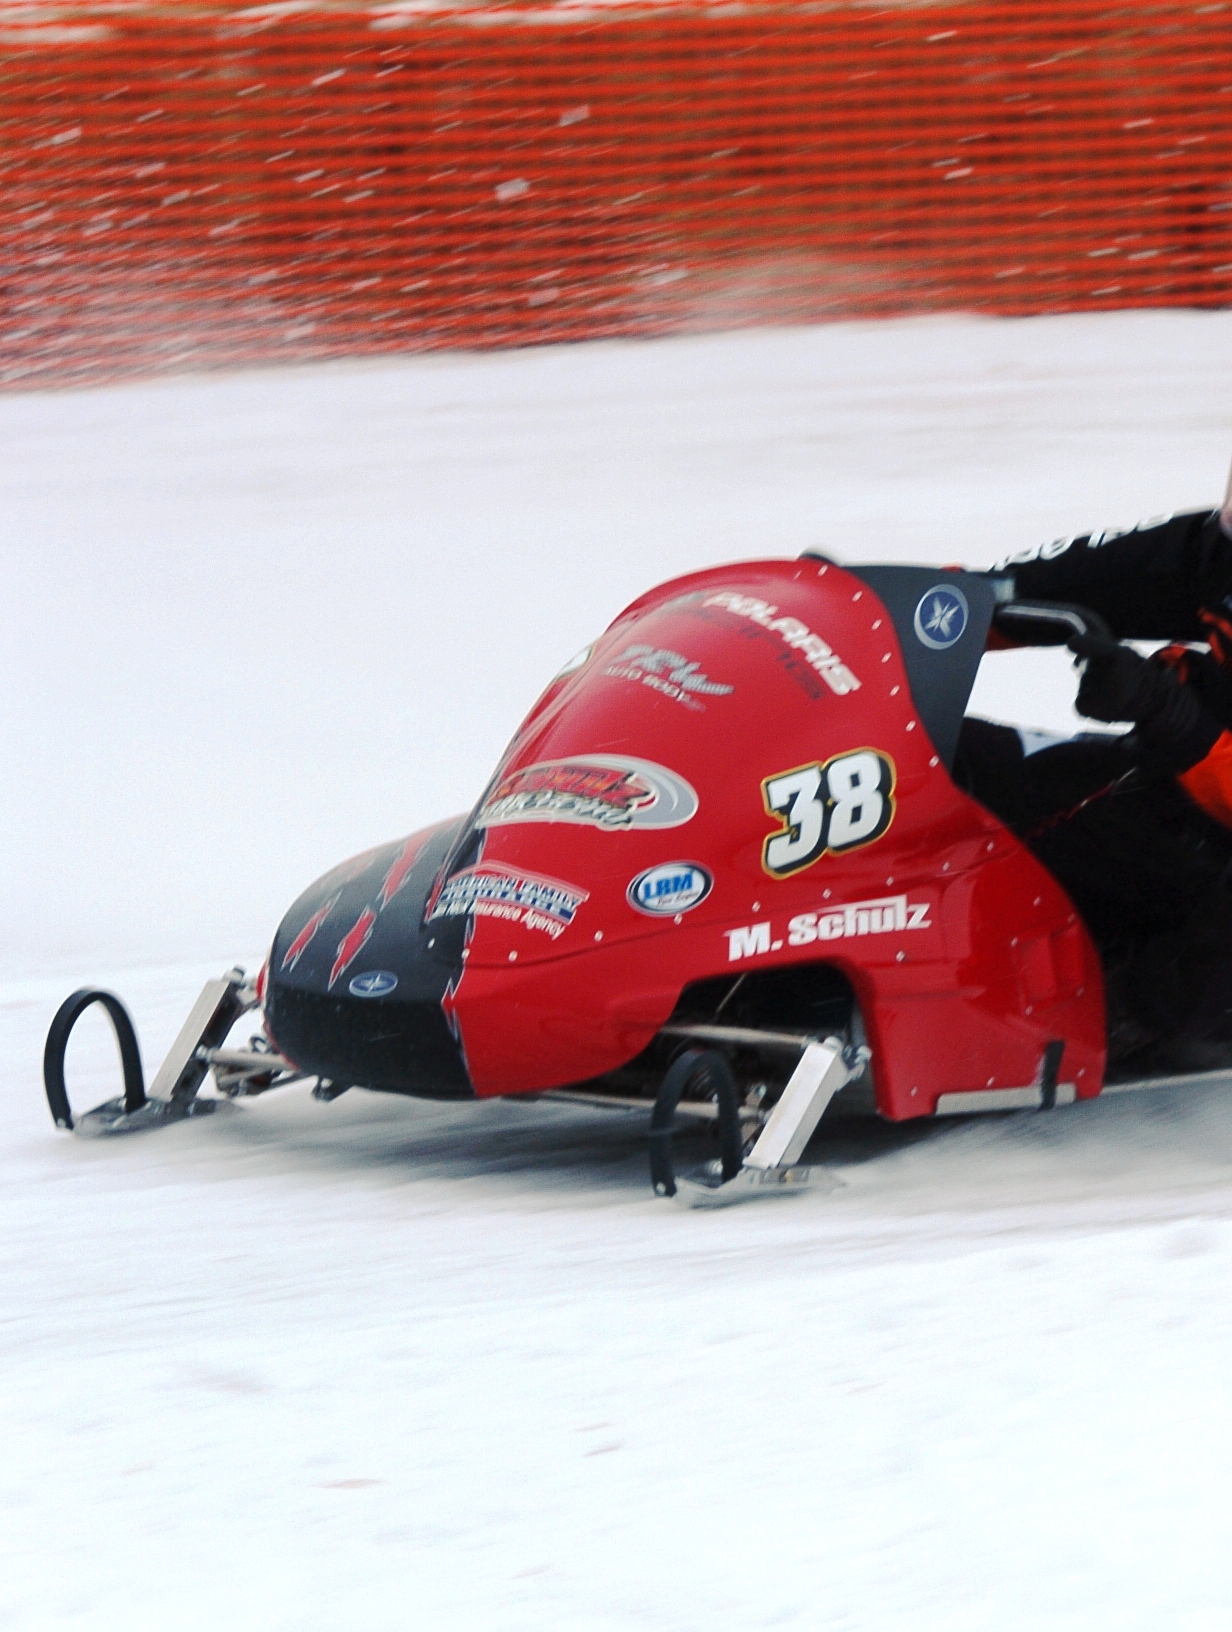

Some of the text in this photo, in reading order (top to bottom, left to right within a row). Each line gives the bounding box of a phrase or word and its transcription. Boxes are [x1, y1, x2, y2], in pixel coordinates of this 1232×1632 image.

[702, 591, 863, 696] POLARIS
[761, 747, 897, 878] 38
[723, 894, 932, 962] M. Schulz
